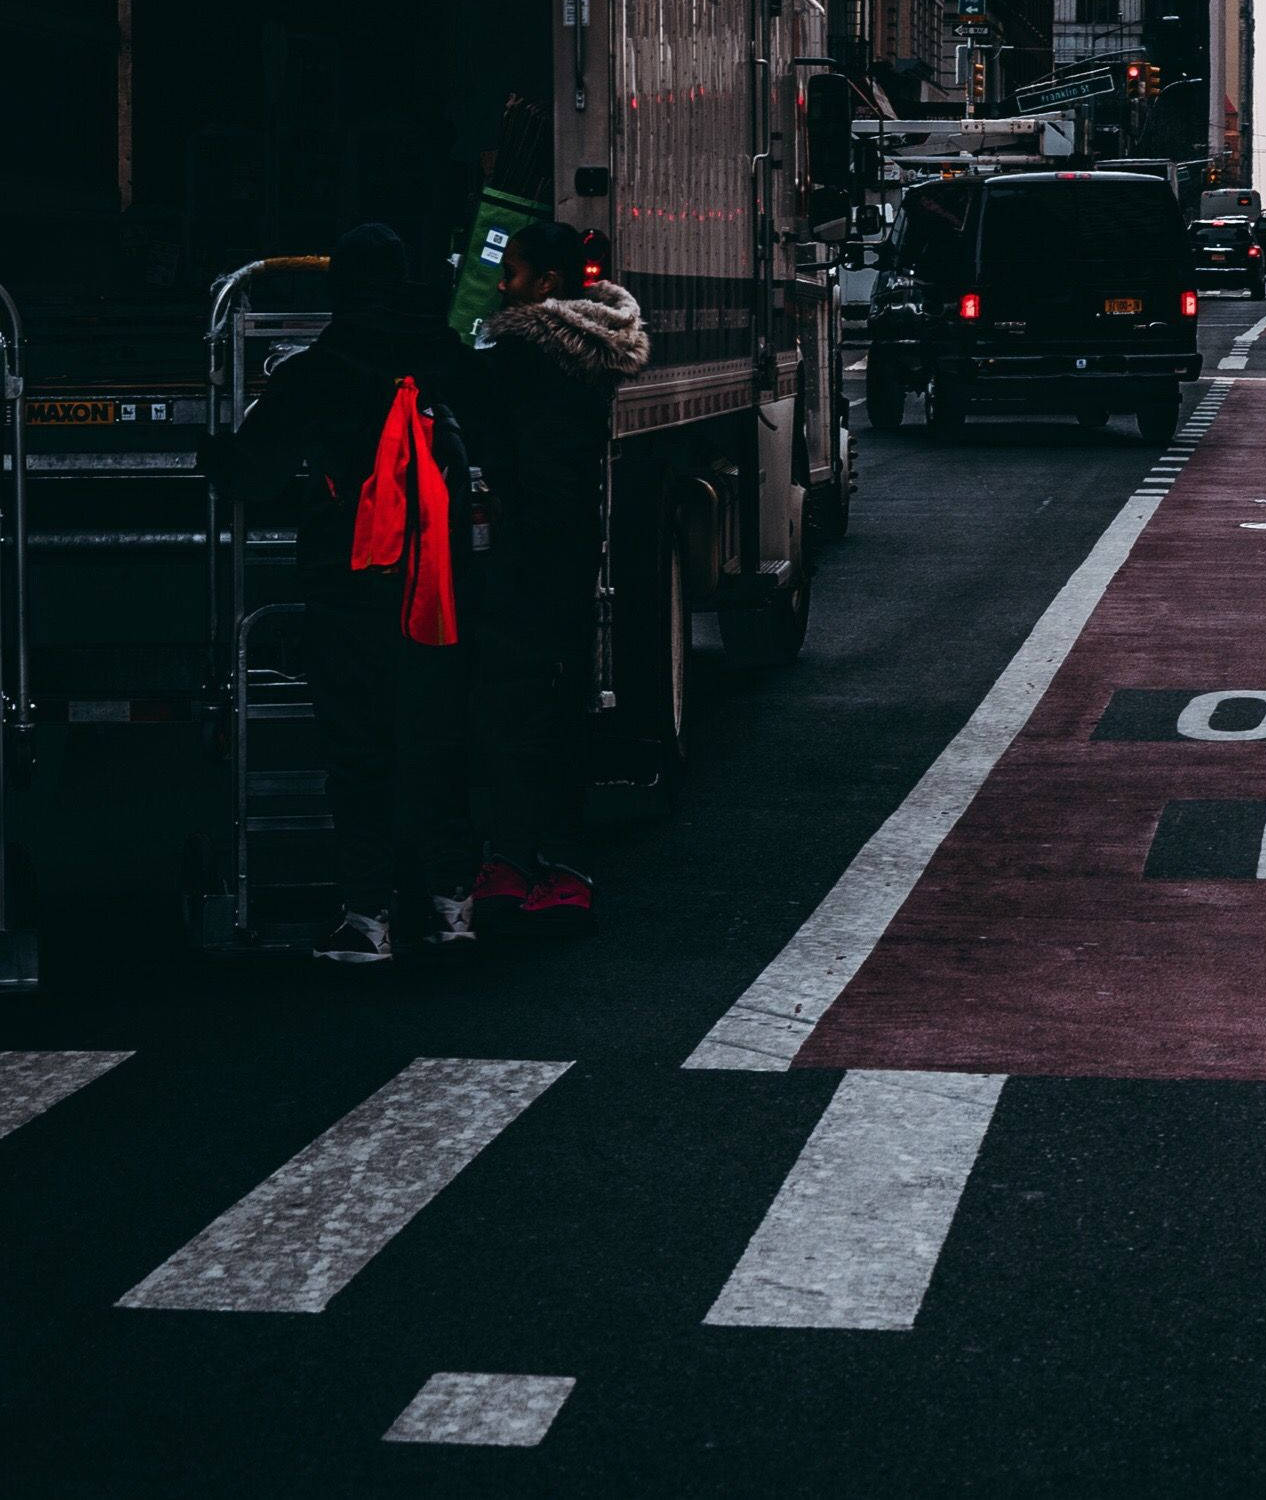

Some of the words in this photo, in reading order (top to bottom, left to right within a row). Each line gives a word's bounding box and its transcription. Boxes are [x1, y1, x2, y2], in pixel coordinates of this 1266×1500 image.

[1041, 87, 1078, 101] Franklin
[1081, 80, 1090, 93] St
[29, 404, 108, 422] MAXON
